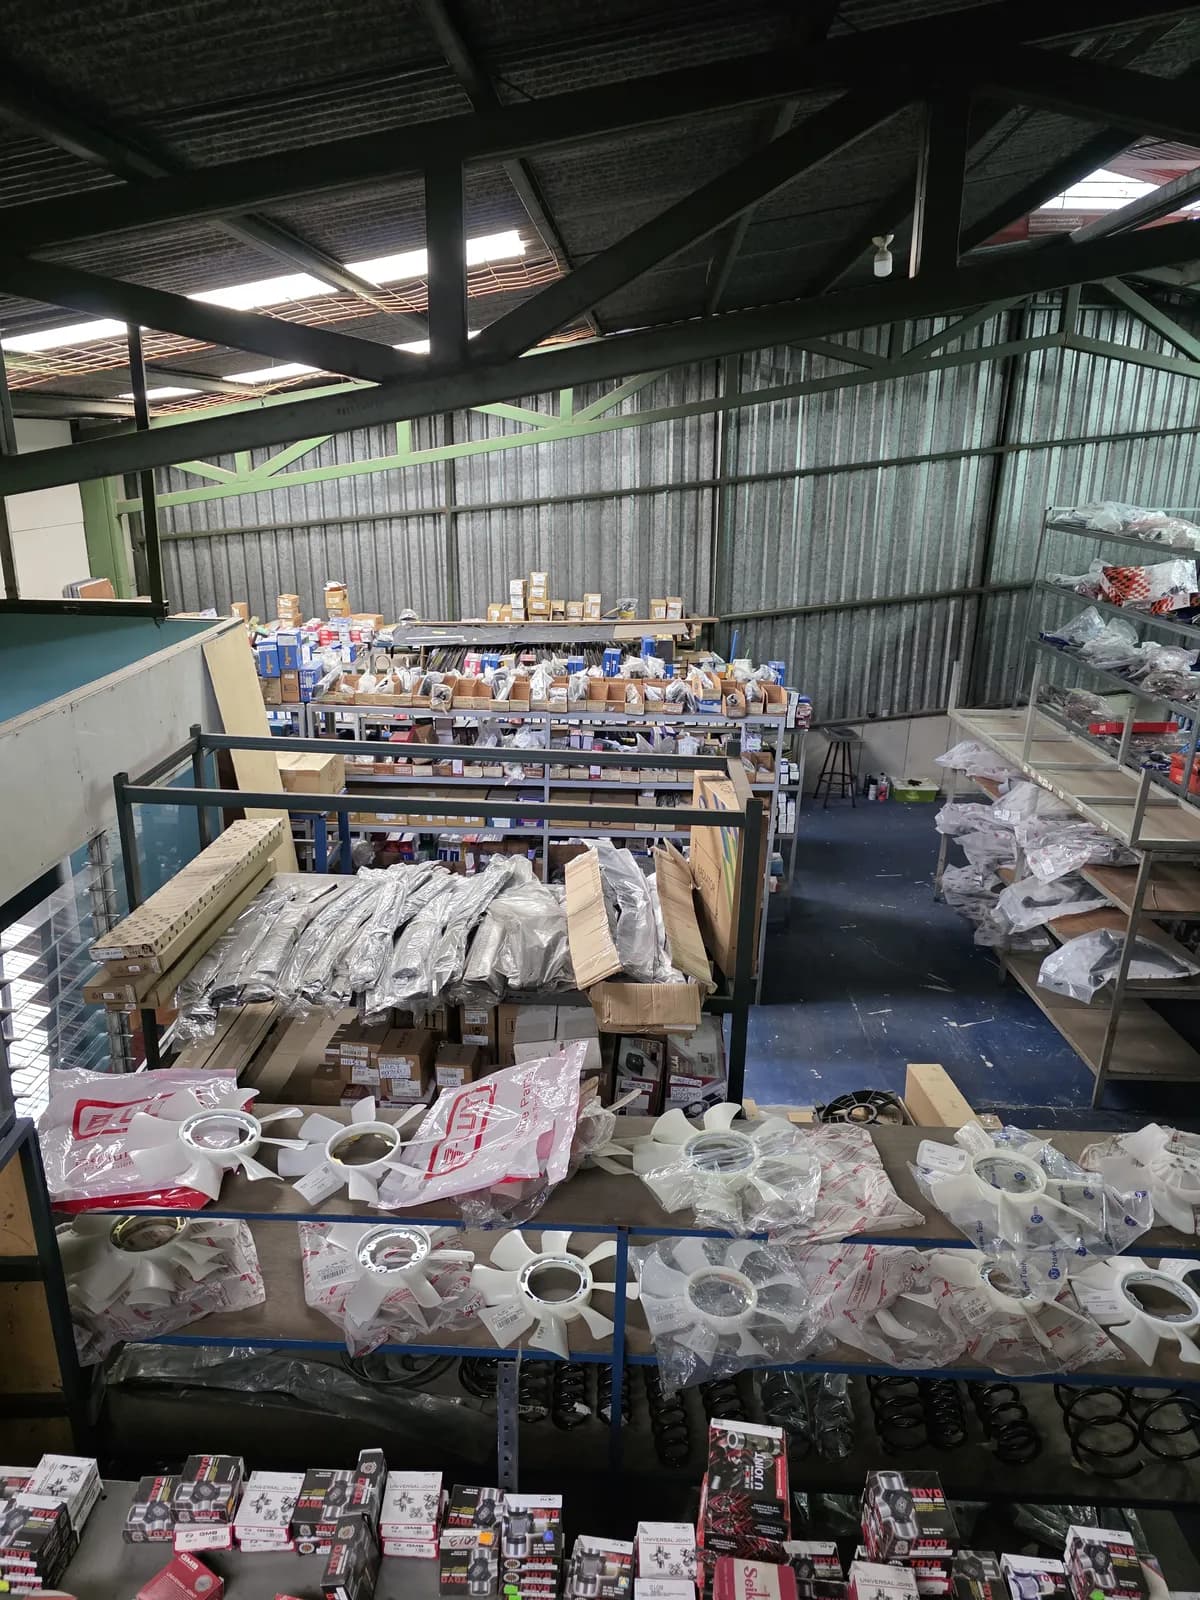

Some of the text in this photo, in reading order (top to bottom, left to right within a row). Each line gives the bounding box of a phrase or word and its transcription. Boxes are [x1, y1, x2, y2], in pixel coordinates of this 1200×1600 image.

[753, 1451, 767, 1490] U JOINT
[910, 1488, 943, 1498] TOYO
[32, 1509, 59, 1519] TOYO
[918, 1539, 948, 1548] TOYO
[1108, 1544, 1136, 1556] TOYO
[180, 1553, 199, 1570] GMB
[327, 1544, 342, 1575] TOYO
[911, 1560, 942, 1568] TOYO
